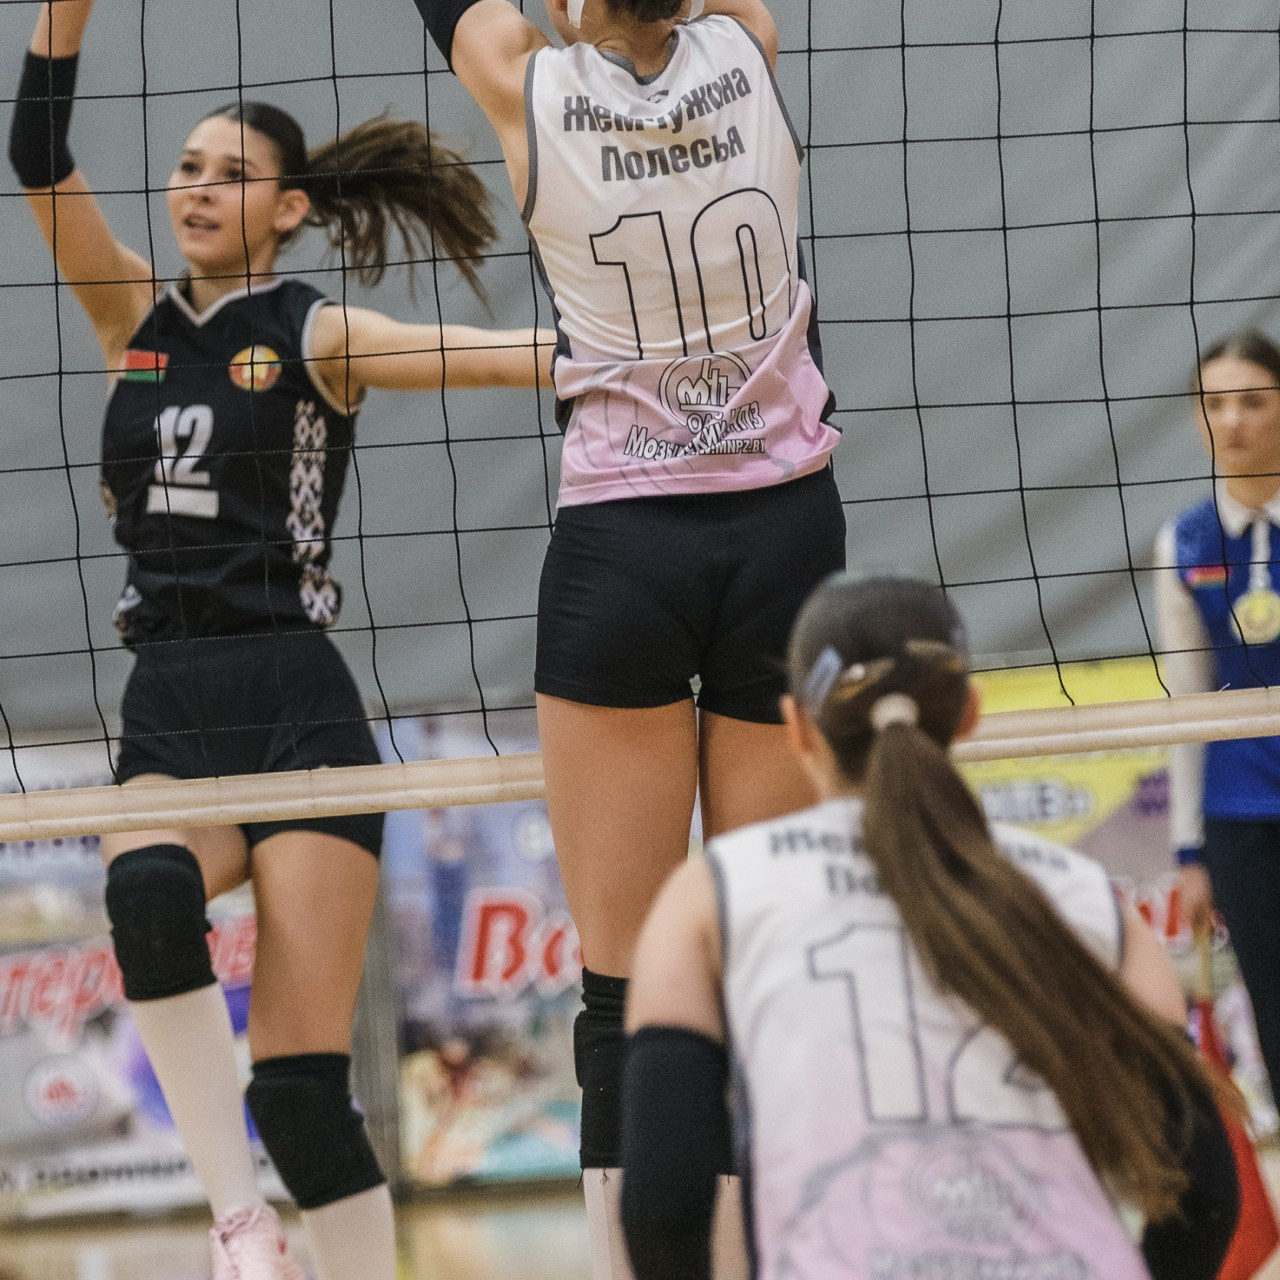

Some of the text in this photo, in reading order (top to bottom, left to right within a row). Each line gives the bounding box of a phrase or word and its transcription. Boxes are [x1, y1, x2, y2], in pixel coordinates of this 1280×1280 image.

[601, 125, 746, 181] Полесья
[589, 187, 792, 360] 10
[153, 404, 215, 486] 12
